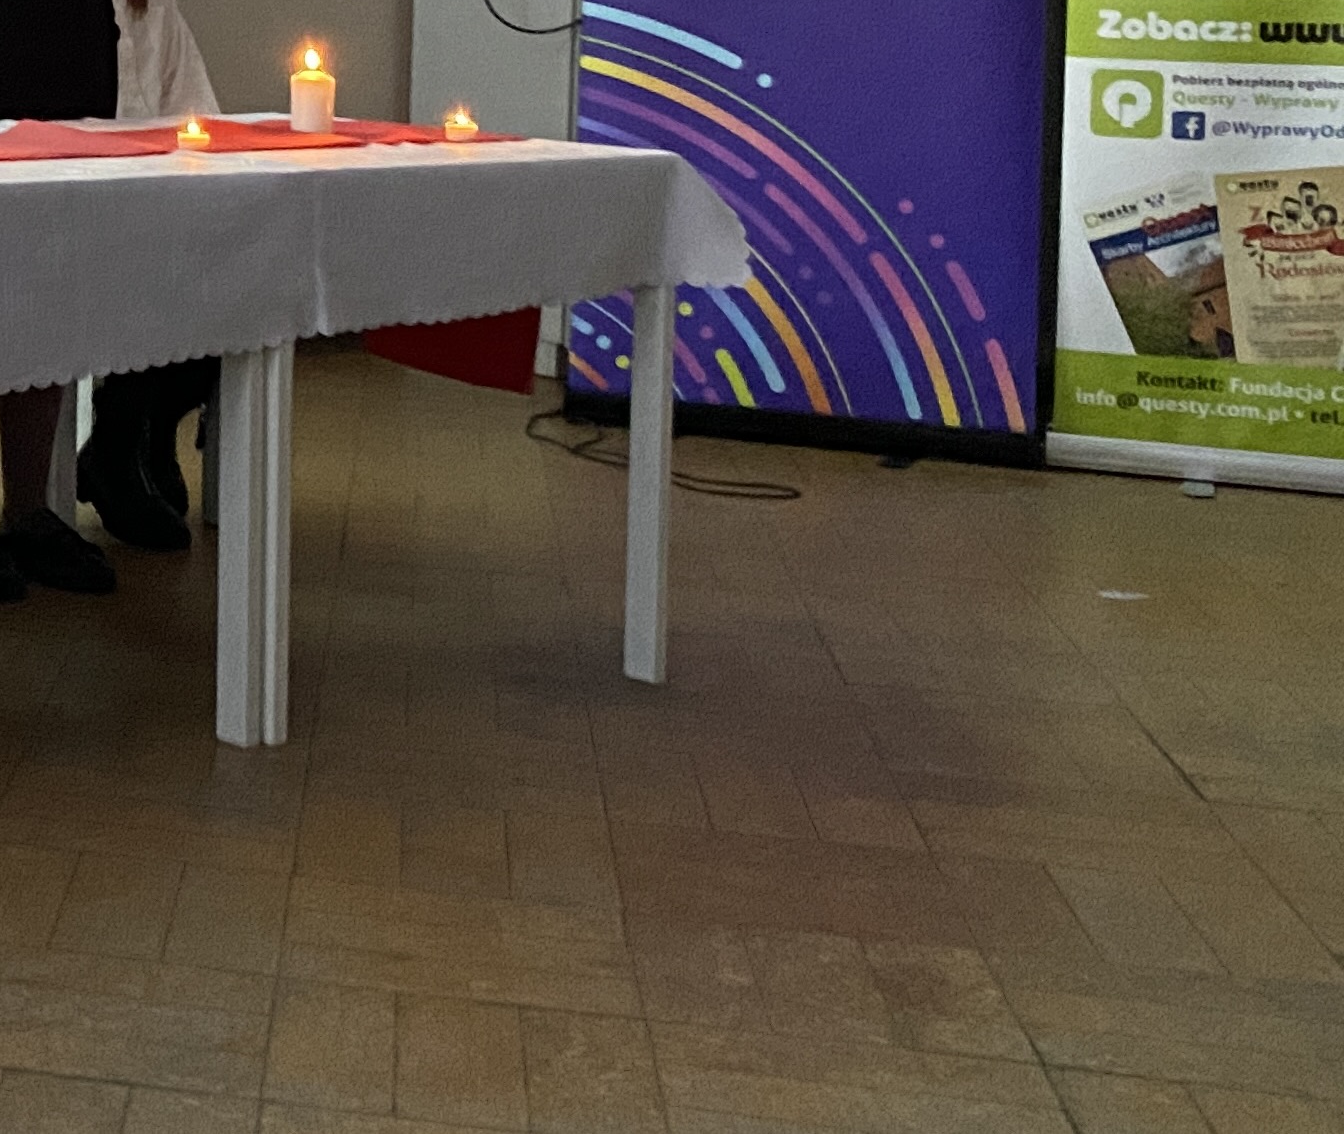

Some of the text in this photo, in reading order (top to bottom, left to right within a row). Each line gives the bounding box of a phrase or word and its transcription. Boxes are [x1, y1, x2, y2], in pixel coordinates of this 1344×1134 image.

[1096, 9, 1253, 42] Zobacz:
[1172, 74, 1224, 87] Pobierz
[1172, 91, 1236, 108] Questy
[1253, 94, 1340, 112] Wyprawy
[1136, 371, 1224, 393] Kontakt:
[1229, 377, 1325, 404] Fundacja
[1076, 387, 1289, 424] info@questy.com.pl
